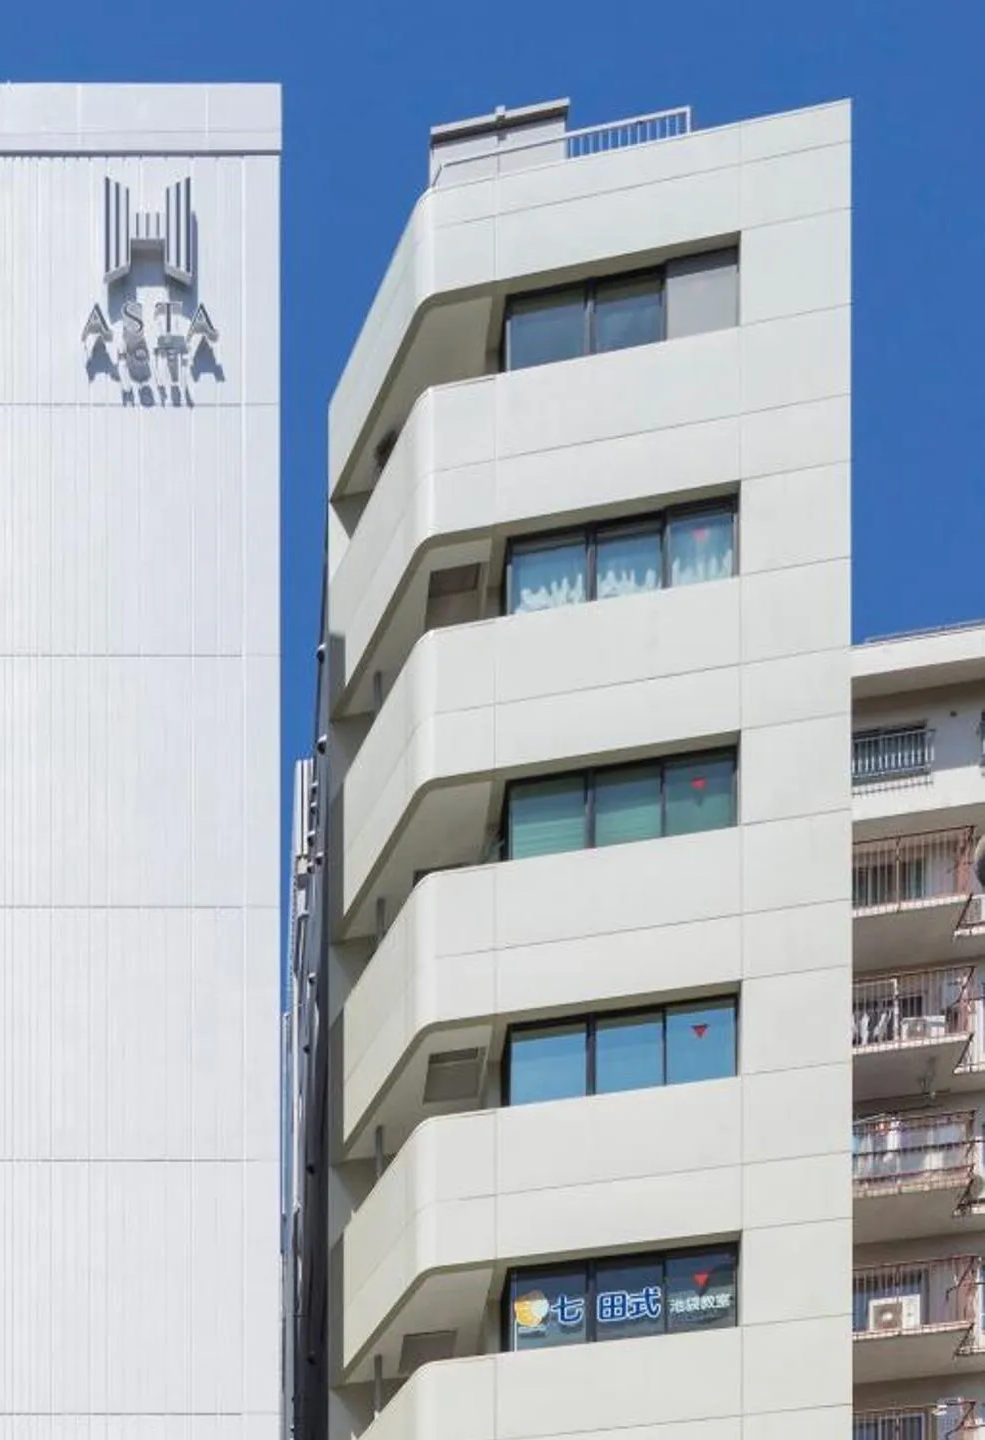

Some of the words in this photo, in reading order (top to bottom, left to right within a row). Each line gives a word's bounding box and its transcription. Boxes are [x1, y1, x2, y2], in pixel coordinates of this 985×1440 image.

[81, 301, 220, 342] ASTA
[550, 1285, 662, 1325] 七田式
